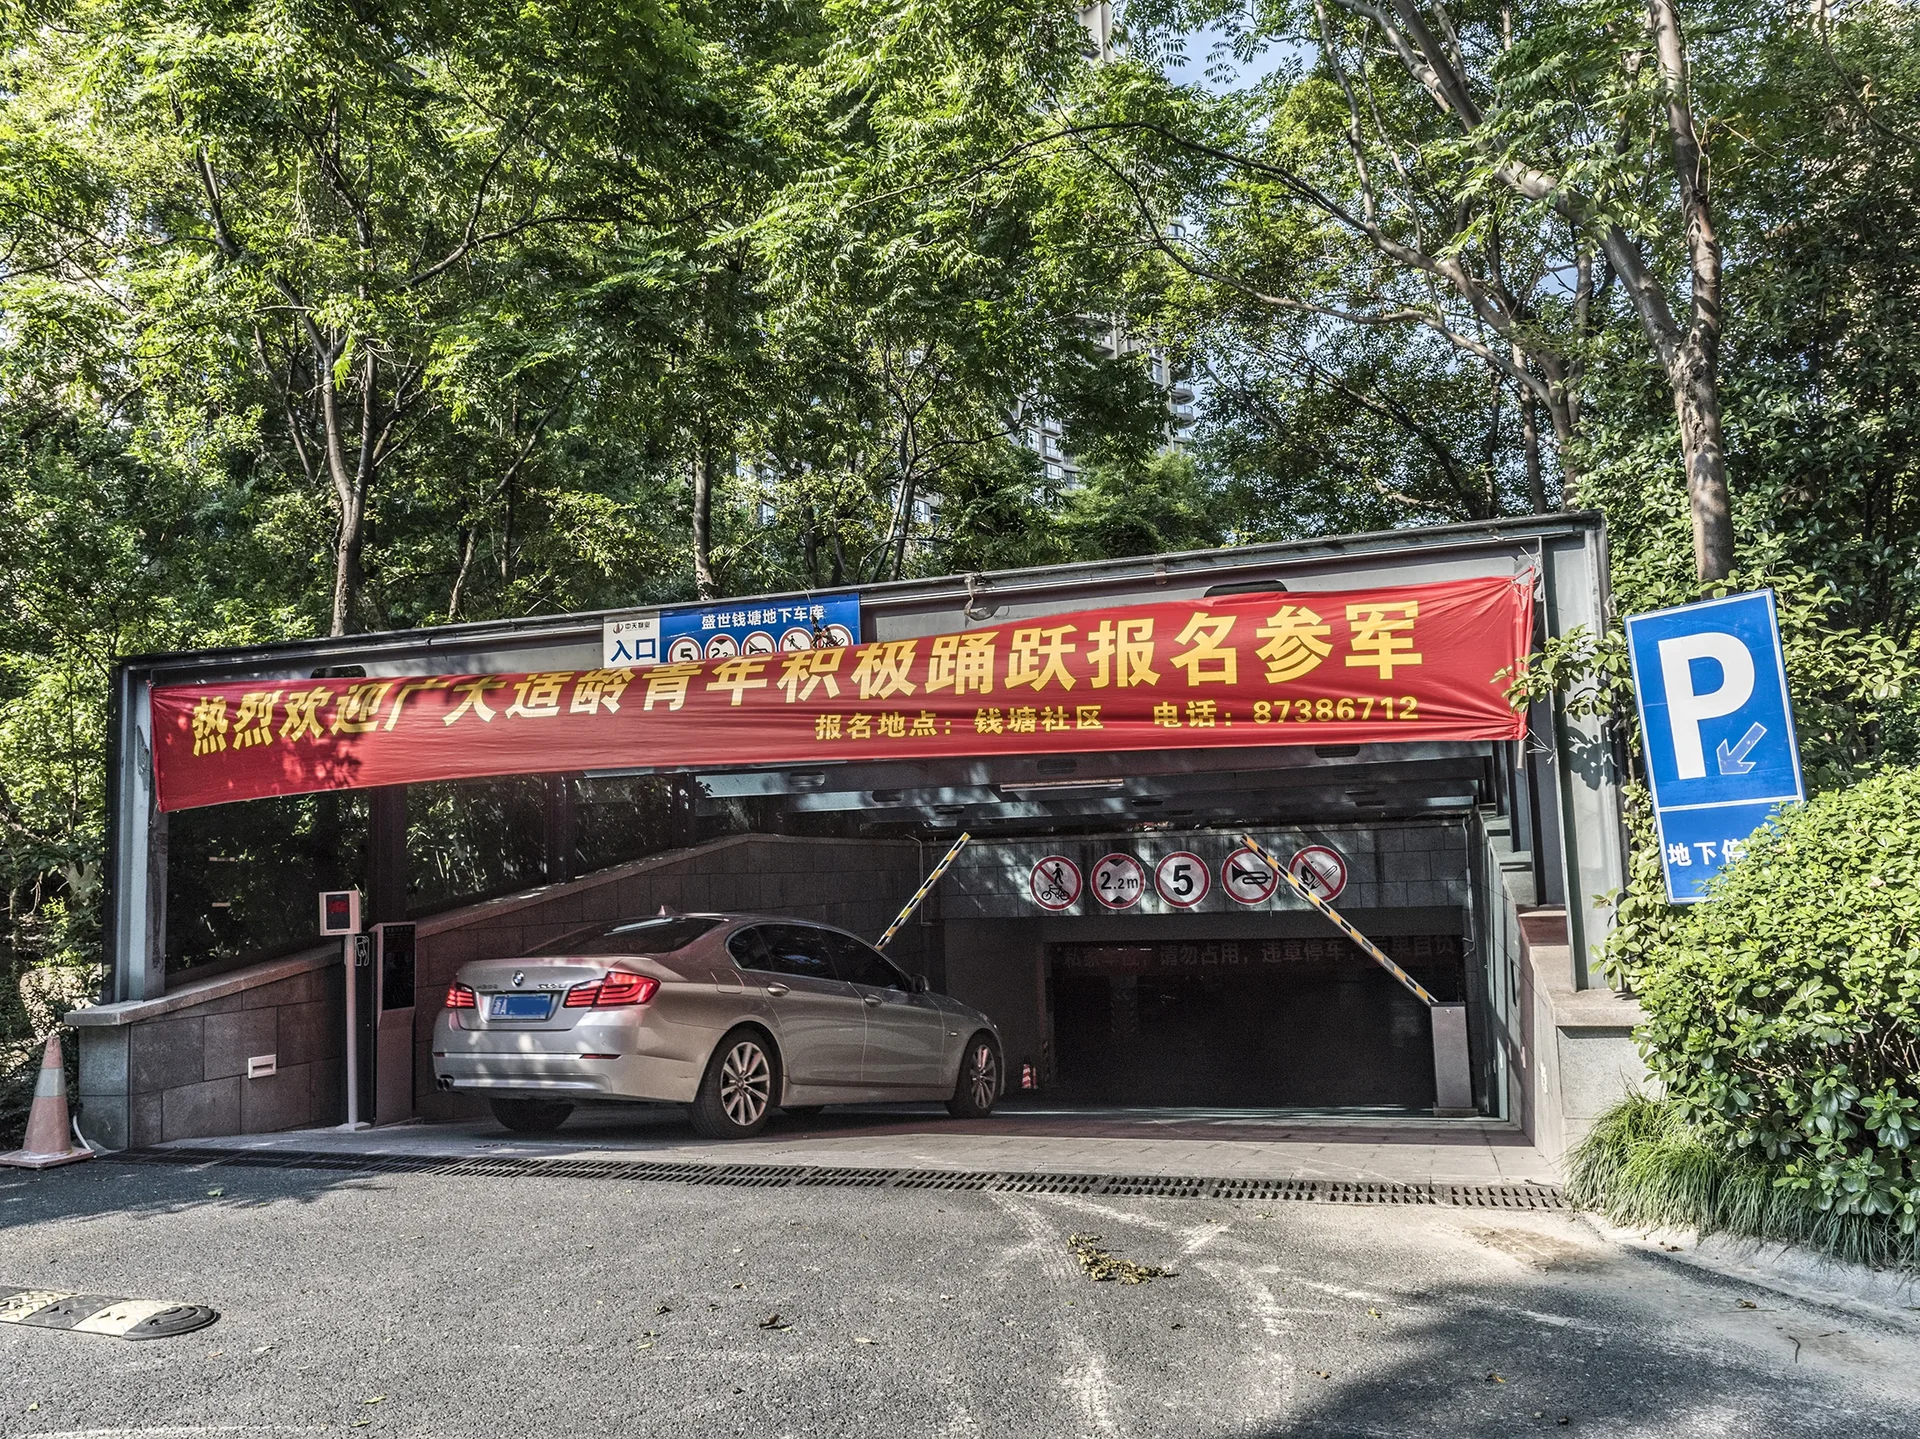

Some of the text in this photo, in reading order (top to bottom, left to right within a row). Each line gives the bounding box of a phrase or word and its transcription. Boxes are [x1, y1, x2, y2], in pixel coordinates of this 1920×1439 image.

[702, 604, 825, 629] 盛世钱塘地下车库
[610, 638, 656, 662] 入口
[191, 599, 1423, 757] 热烈欢迎广大适龄青年积极踊跃报名参军
[1658, 632, 1755, 779] P
[1173, 865, 1193, 896] 5
